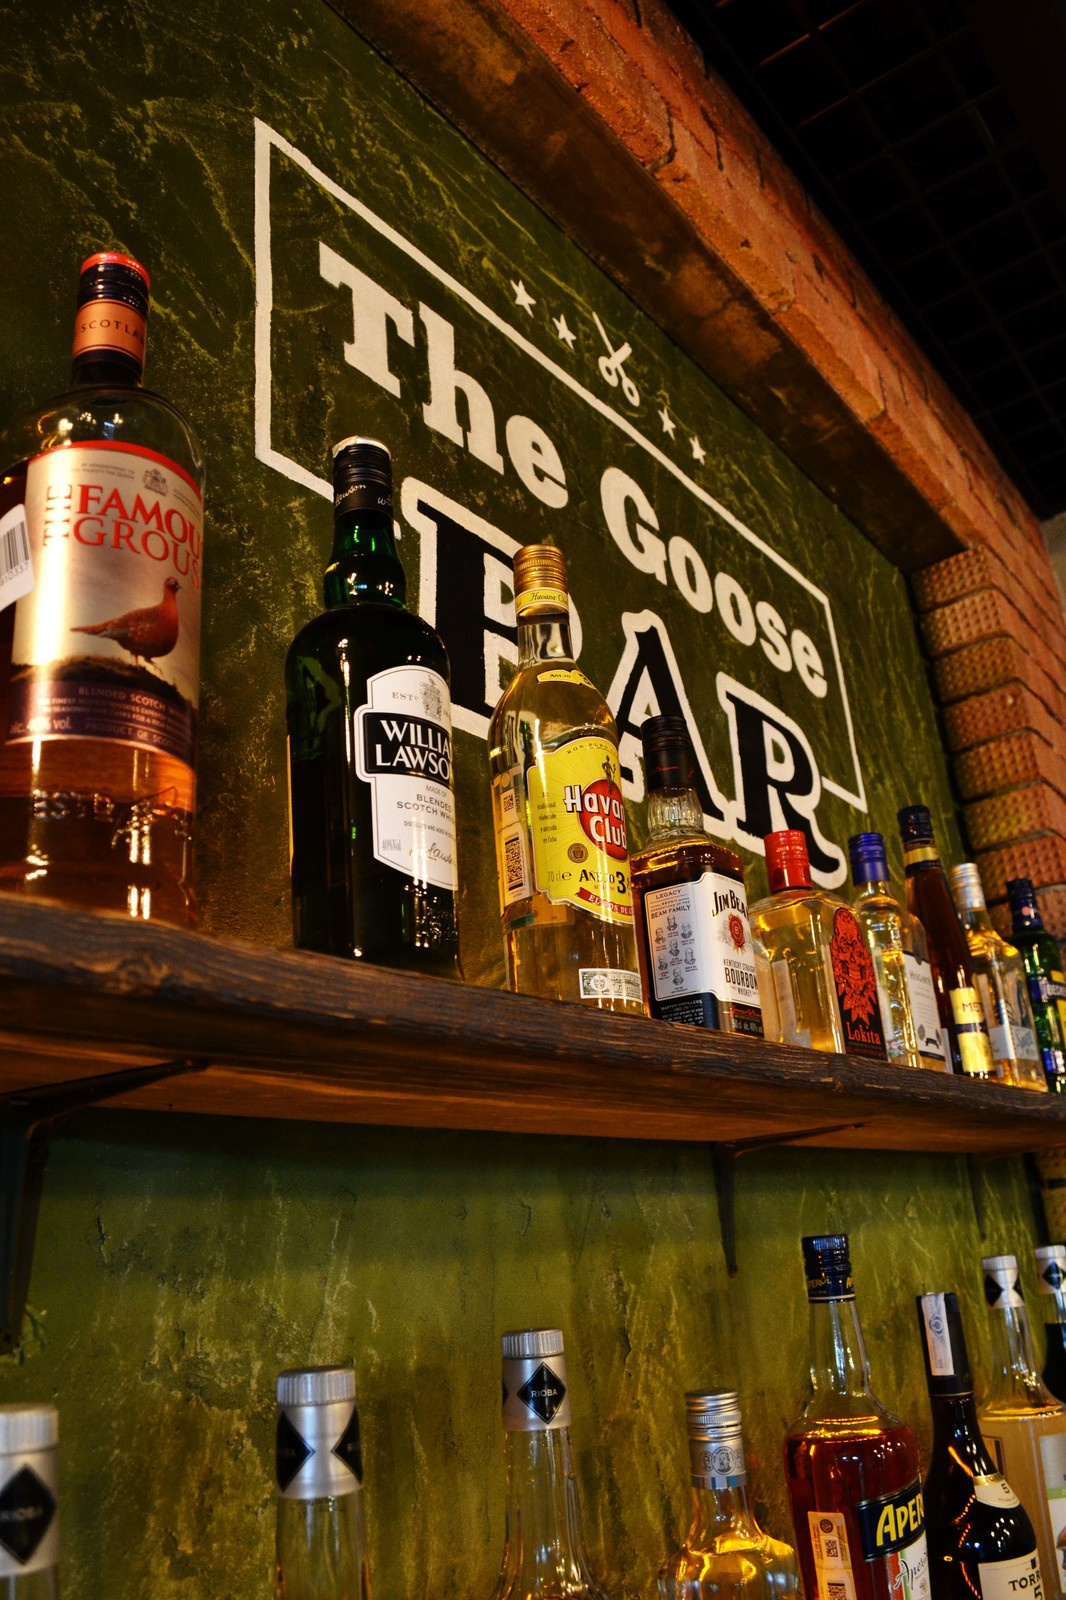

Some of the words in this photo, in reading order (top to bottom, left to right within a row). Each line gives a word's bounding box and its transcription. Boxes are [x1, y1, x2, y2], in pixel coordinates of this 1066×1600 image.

[319, 241, 569, 510] The
[600, 467, 829, 699] Goose
[400, 476, 848, 890] BAR
[130, 694, 165, 711] SCOTCH
[375, 743, 451, 780] LAWSO
[396, 801, 438, 816] SCOTCH
[615, 870, 627, 894] 3
[588, 894, 601, 906] EL
[620, 906, 628, 915] DE
[655, 889, 682, 900] LEGACY
[712, 890, 730, 918] JIM
[651, 910, 668, 919] BEAM
[668, 904, 691, 914] FAMILY
[845, 1021, 882, 1045] Lokita
[530, 1388, 559, 1398] RIOBA
